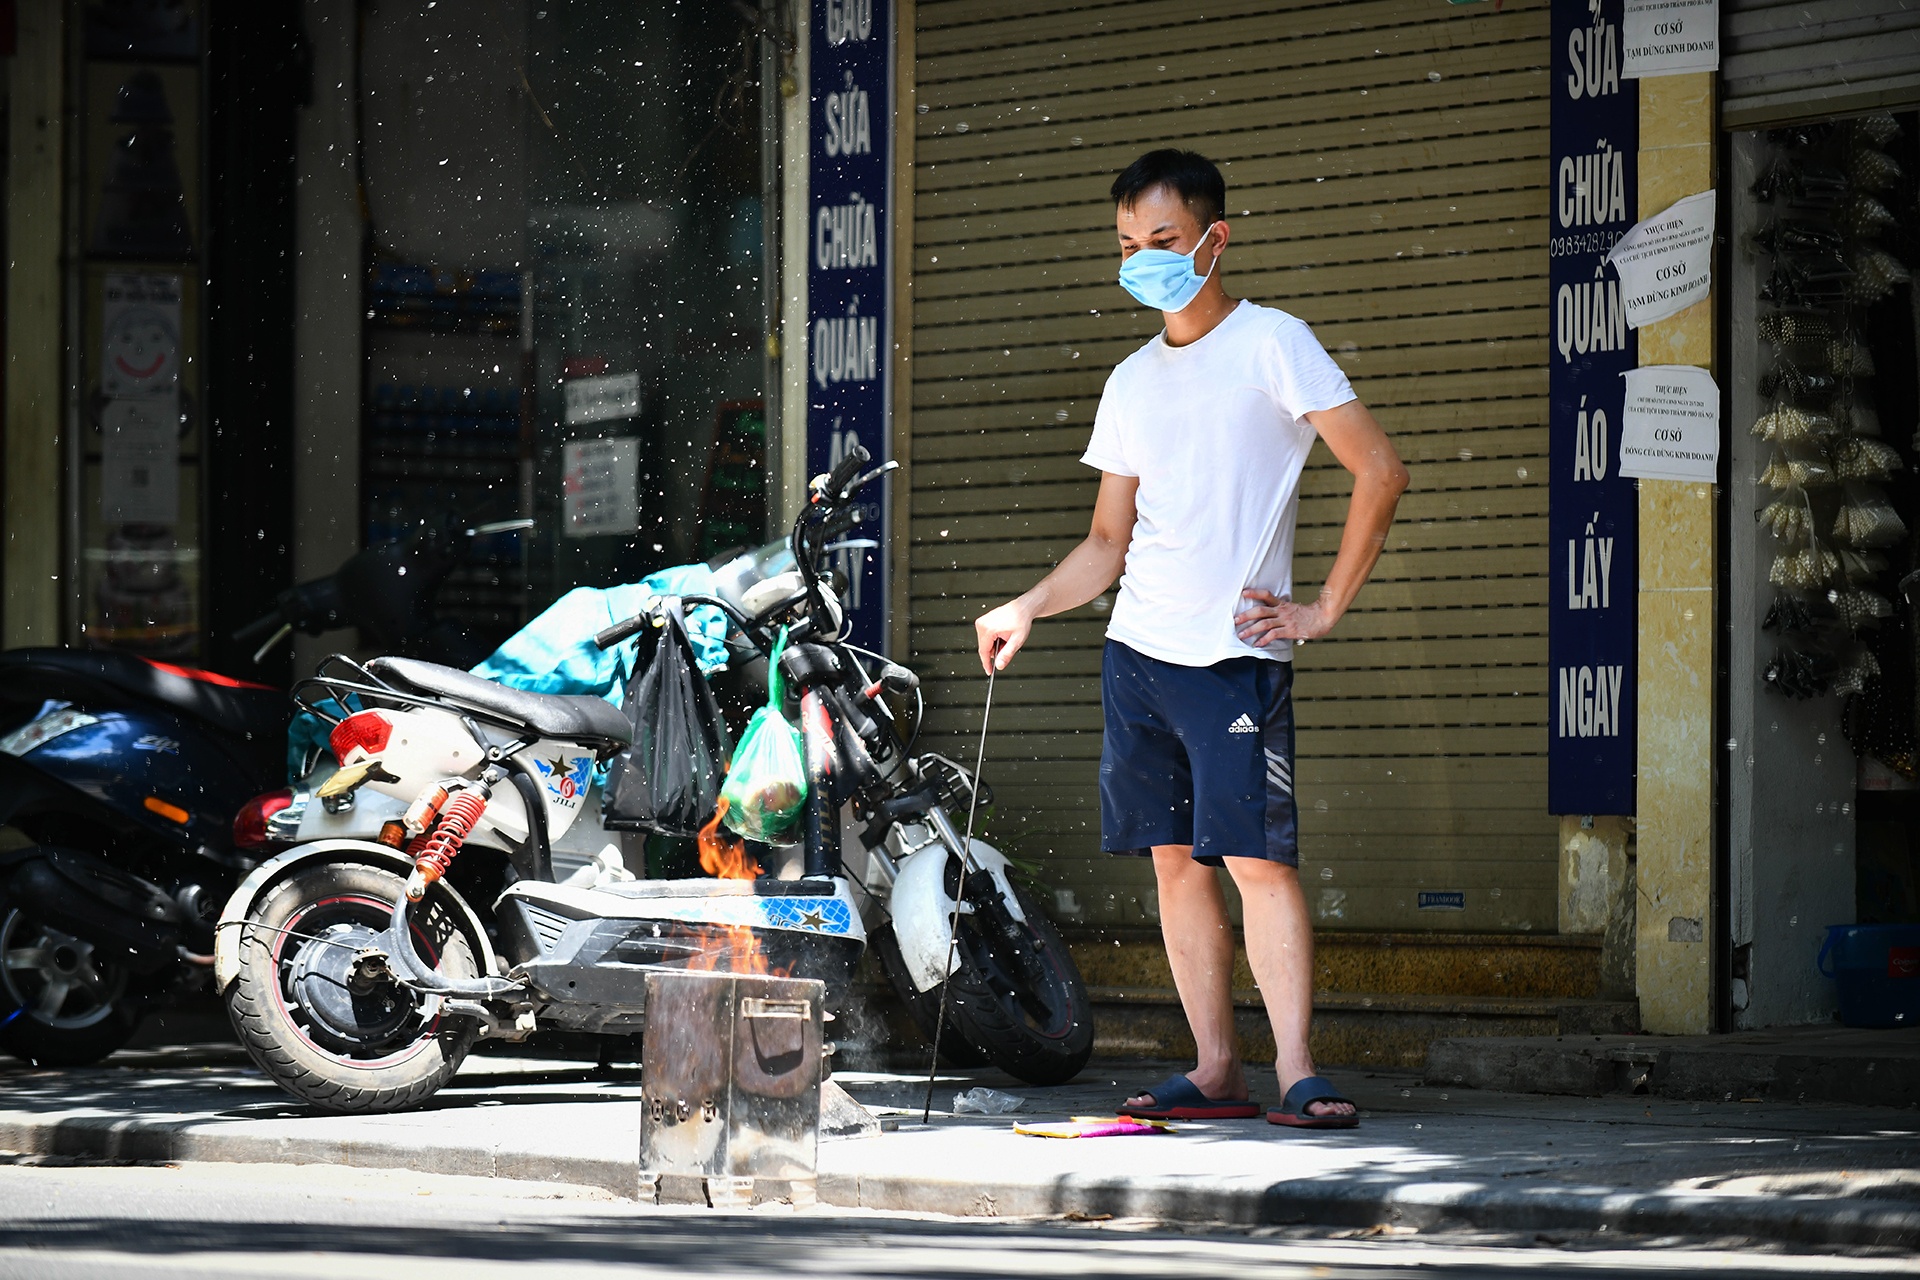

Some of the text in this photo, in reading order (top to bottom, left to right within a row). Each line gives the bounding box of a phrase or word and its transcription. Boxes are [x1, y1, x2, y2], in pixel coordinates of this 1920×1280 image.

[1654, 18, 1684, 36] CƠ SỞ
[1626, 40, 1714, 60] TẠM DỪNG KINH DOANH
[824, 69, 871, 158] SỬA
[1558, 138, 1626, 229] CHỮA
[816, 191, 877, 270] CHỮA
[1644, 218, 1684, 235] THỰC HIỆN
[1656, 259, 1687, 281] CƠ SỞ
[1627, 274, 1708, 310] TẠM DỪNG KINH DOANH
[1558, 255, 1626, 364] QUẦN
[1655, 384, 1688, 396] THỰC HIỆN
[1573, 395, 1608, 482] ÁO
[1654, 427, 1683, 442] CƠ SỞ
[1625, 445, 1714, 462] ĐÓNG CỬA DỪNG KINH DOANH
[1569, 511, 1614, 610] LẤY
[1559, 665, 1623, 738] NGAY
[1228, 726, 1260, 734] adidas
[553, 796, 576, 809] JILI
